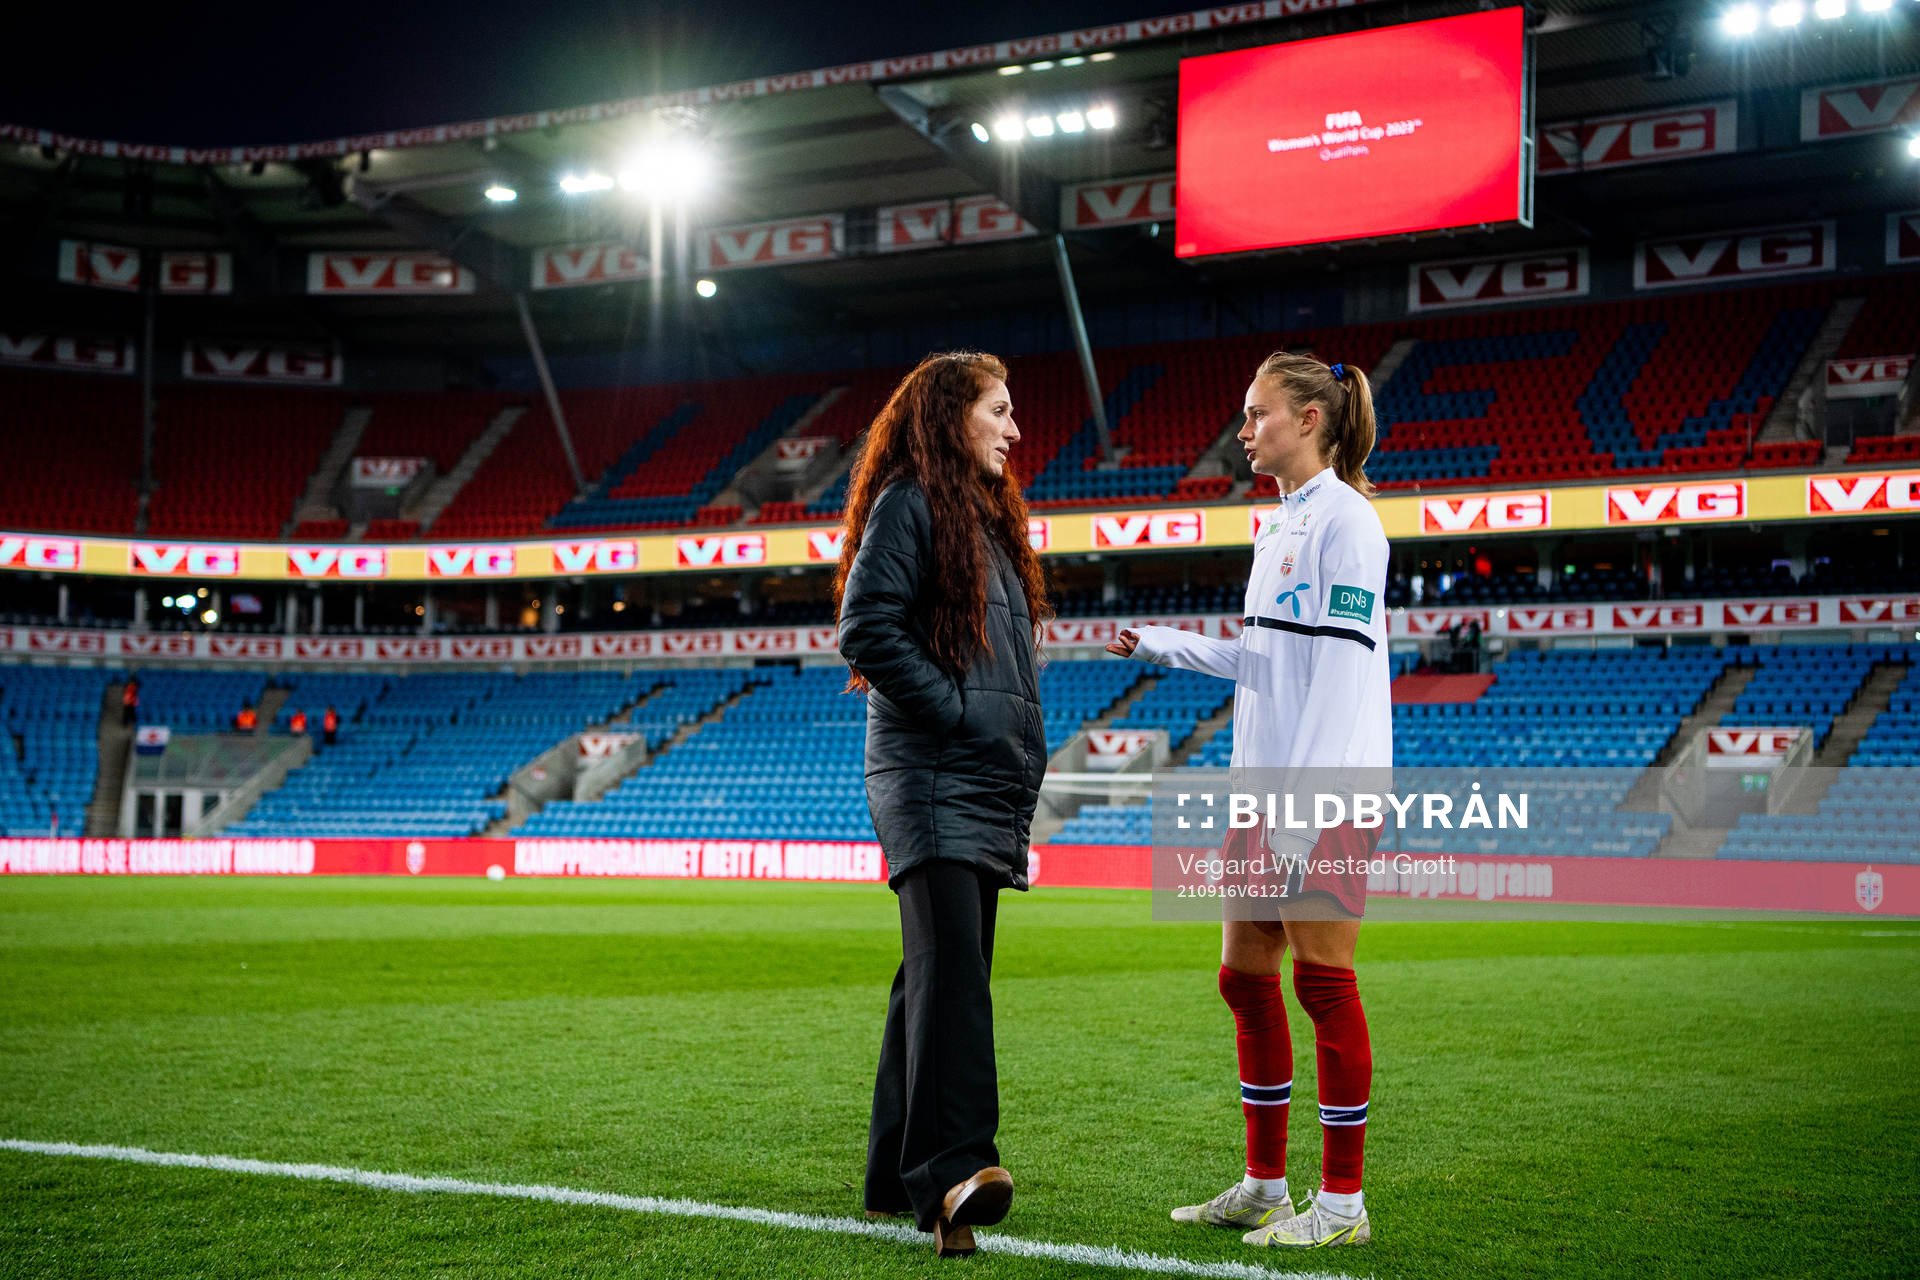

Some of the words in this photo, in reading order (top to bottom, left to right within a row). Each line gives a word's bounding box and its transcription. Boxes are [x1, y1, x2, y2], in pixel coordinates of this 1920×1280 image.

[1325, 110, 1362, 130] FIFA
[1822, 83, 1920, 131] V
[1322, 128, 1359, 145] World
[1360, 126, 1384, 142] Cup
[1543, 113, 1706, 166] VG
[900, 204, 1018, 241] VG
[714, 225, 825, 263] VG
[1651, 232, 1813, 278] VG
[86, 248, 207, 290] VG
[329, 257, 455, 288] VG
[550, 246, 655, 281] VG
[1424, 258, 1569, 300] VG
[203, 350, 325, 378] VG
[1831, 362, 1908, 381] VG
[1425, 494, 1543, 531] VG
[1609, 484, 1738, 522] VG
[1095, 513, 1199, 547] VG
[134, 544, 237, 575] VG
[289, 549, 384, 577] VG
[431, 546, 513, 576] VG
[555, 541, 635, 573] VG
[678, 535, 763, 568] VG
[1340, 590, 1367, 609] DNB
[1512, 609, 1587, 630] VG
[1617, 605, 1696, 627] VG
[1727, 602, 1811, 624] VG
[35, 633, 99, 652] VG
[127, 636, 188, 656] VG
[215, 639, 277, 657] VG
[300, 640, 358, 658] VG
[381, 640, 436, 659] VG
[455, 640, 509, 659] VG
[529, 639, 578, 658] VG
[598, 636, 646, 656] VG
[666, 634, 717, 654] VG
[739, 631, 791, 652] VG
[1050, 621, 1111, 642] VG
[515, 840, 701, 877] KAMPPROGRAMMET
[784, 842, 882, 881] MOBILEN
